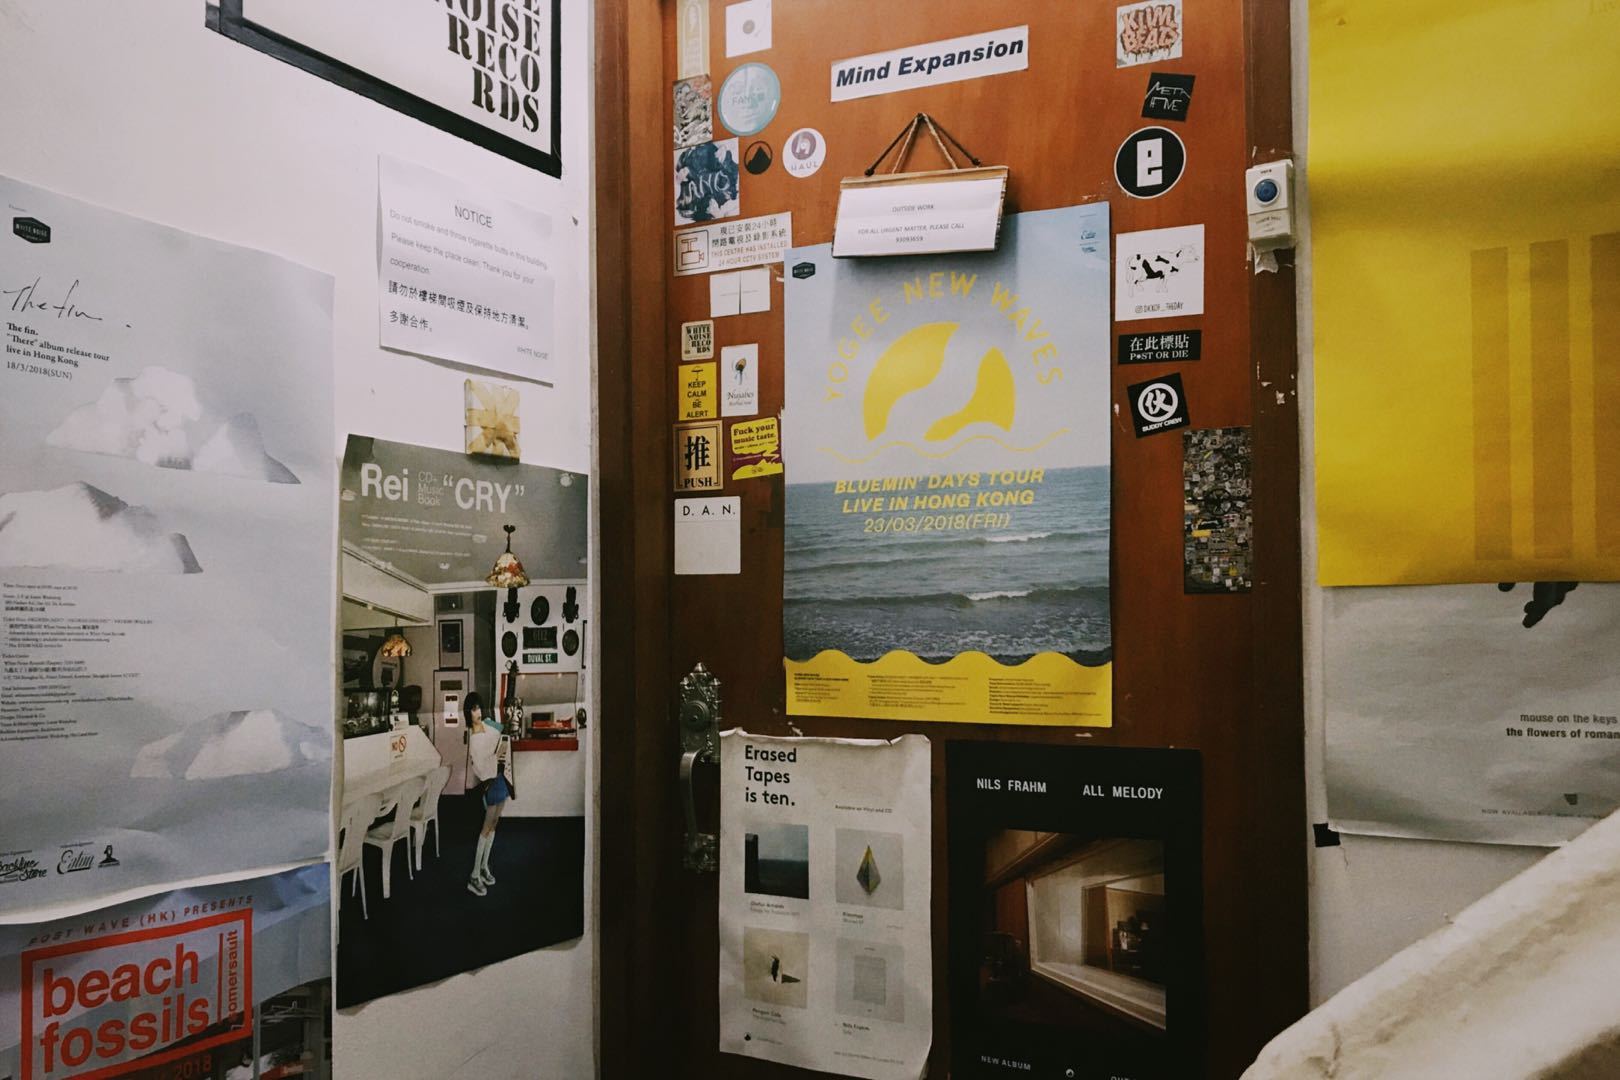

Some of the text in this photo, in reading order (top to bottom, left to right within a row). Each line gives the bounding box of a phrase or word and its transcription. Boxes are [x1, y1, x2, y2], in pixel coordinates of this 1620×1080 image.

[434, 0, 540, 56] OISE
[447, 12, 540, 93] RECO
[836, 40, 1023, 87] Mind Expansion
[472, 66, 539, 132] RDS
[455, 206, 492, 228] NOTICE
[6, 322, 39, 336] The fin.
[686, 325, 711, 334] WHITE
[821, 271, 1064, 402] YOGEE NEW WAVES
[39, 340, 65, 353] album
[66, 345, 92, 359] release
[94, 351, 109, 362] tour
[1130, 334, 1189, 352] 在此標貼
[6, 344, 79, 368] live in Hong Kong
[1172, 350, 1188, 358] DIE
[6, 361, 72, 381] 18/3/2018(SUN)
[734, 424, 775, 436] Fuck your
[1142, 417, 1182, 432] BUDDY CREW
[684, 436, 711, 471] 推
[361, 463, 408, 501] Rei
[684, 477, 712, 488] PUSH
[928, 472, 981, 489] DAYS
[989, 468, 1045, 486] TOUR
[842, 490, 1034, 513] LIVE IN HONG KONG
[864, 513, 1011, 533] 23/03/2018(FRI)
[1520, 714, 1553, 722] mouse
[1573, 714, 1589, 723] the
[1593, 715, 1617, 725] keys
[1506, 728, 1522, 736] the
[1527, 728, 1566, 738] flowers
[1571, 729, 1581, 738] of
[745, 745, 797, 763] Erased
[745, 766, 790, 786] Tapes
[977, 778, 1046, 793] NILS FRAHM
[745, 787, 796, 806] is ten.
[1083, 785, 1163, 799] ALL MELODY
[28, 895, 254, 947] POST WAVE (HK) PRESENTS
[42, 943, 199, 1018] beach
[40, 994, 209, 1073] fossils
[981, 1056, 1031, 1071] NEW ALBUM
